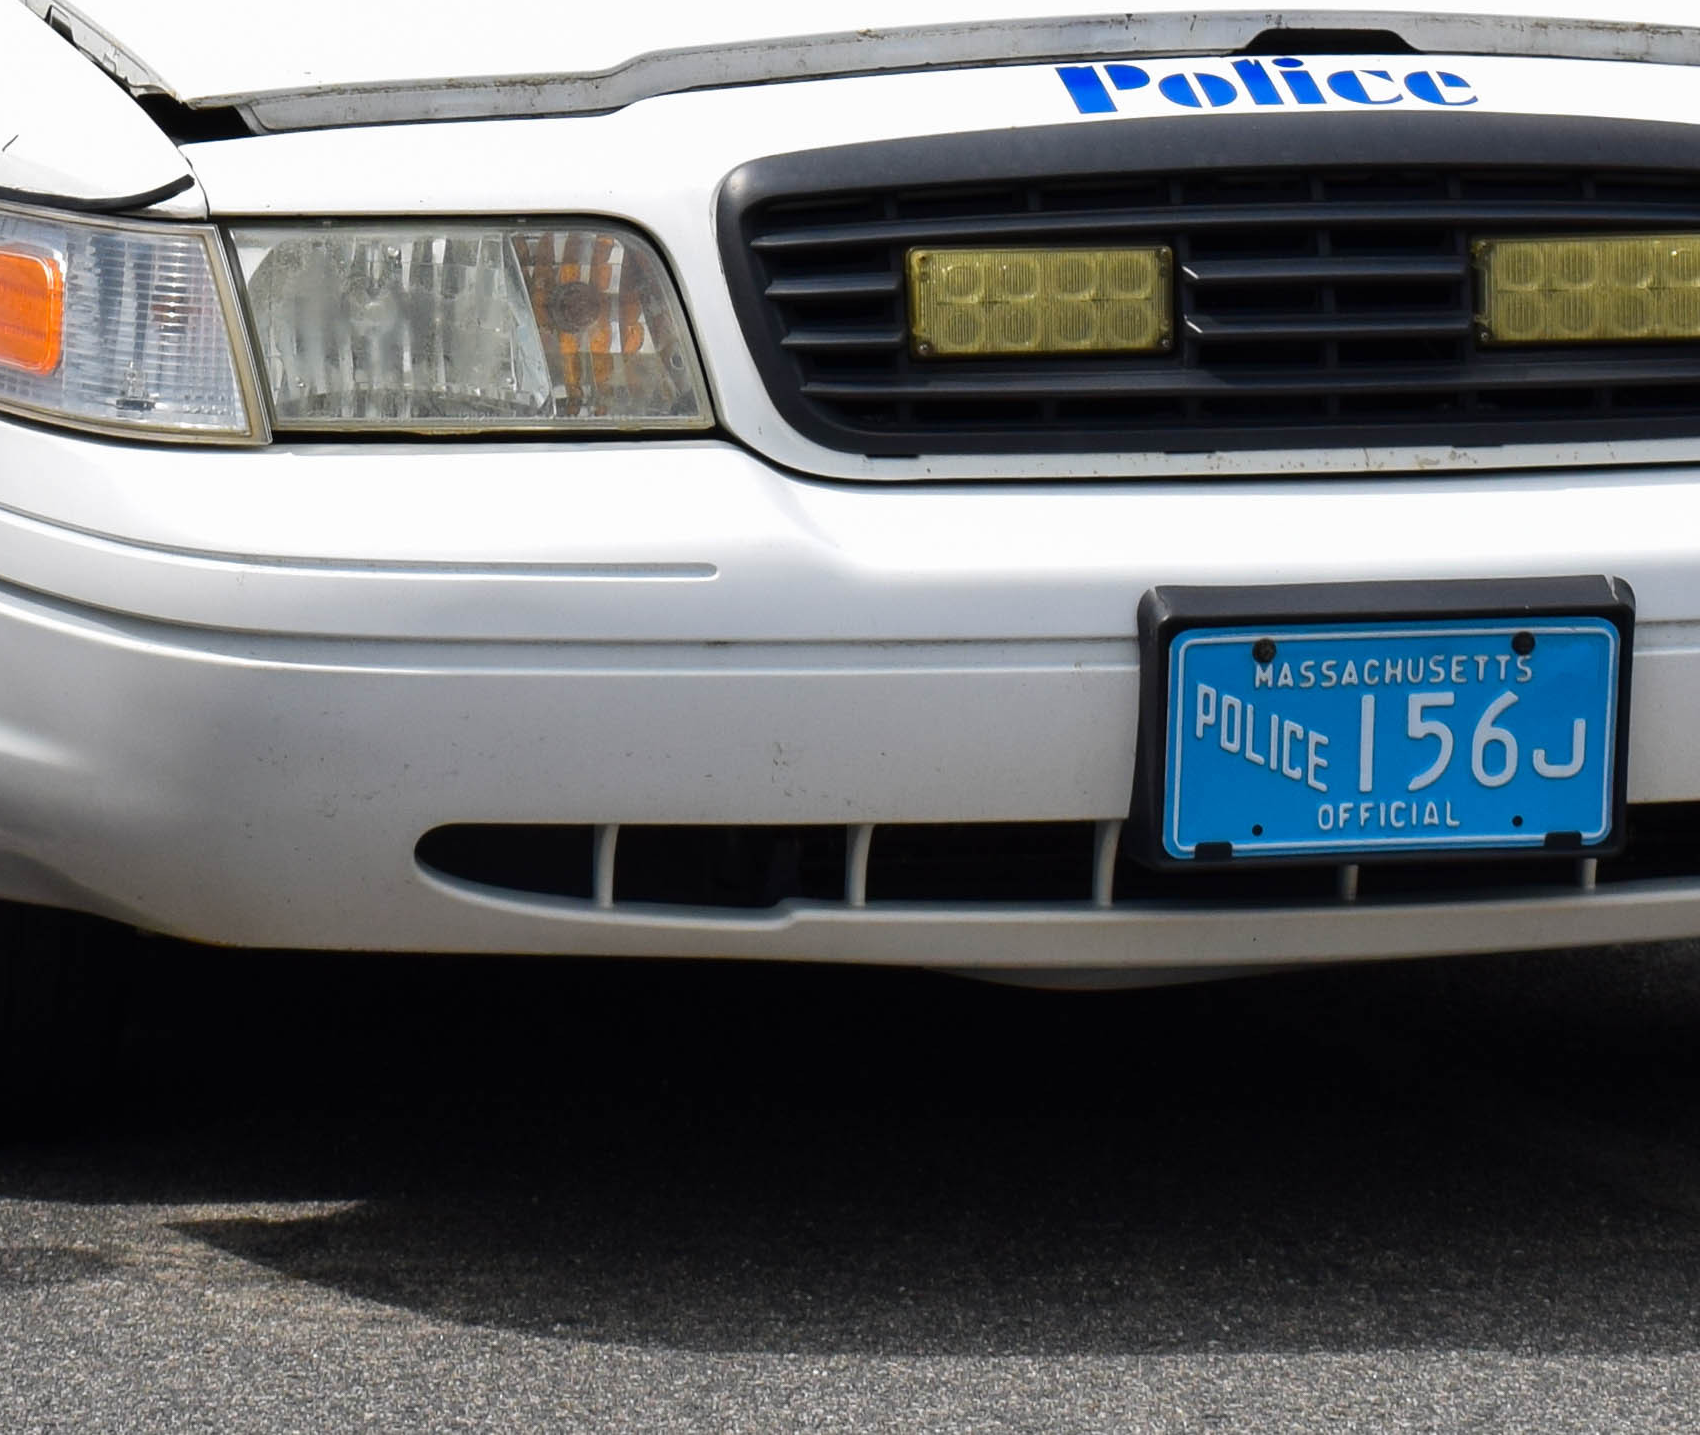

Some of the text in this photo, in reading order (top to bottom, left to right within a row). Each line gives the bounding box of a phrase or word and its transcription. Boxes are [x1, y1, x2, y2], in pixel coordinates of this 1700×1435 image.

[1055, 57, 1478, 114] Police
[1254, 654, 1533, 689] MASSACHUSETTS
[1195, 682, 1587, 793] POLICE 156J
[1317, 800, 1461, 830] OFFICIAL
